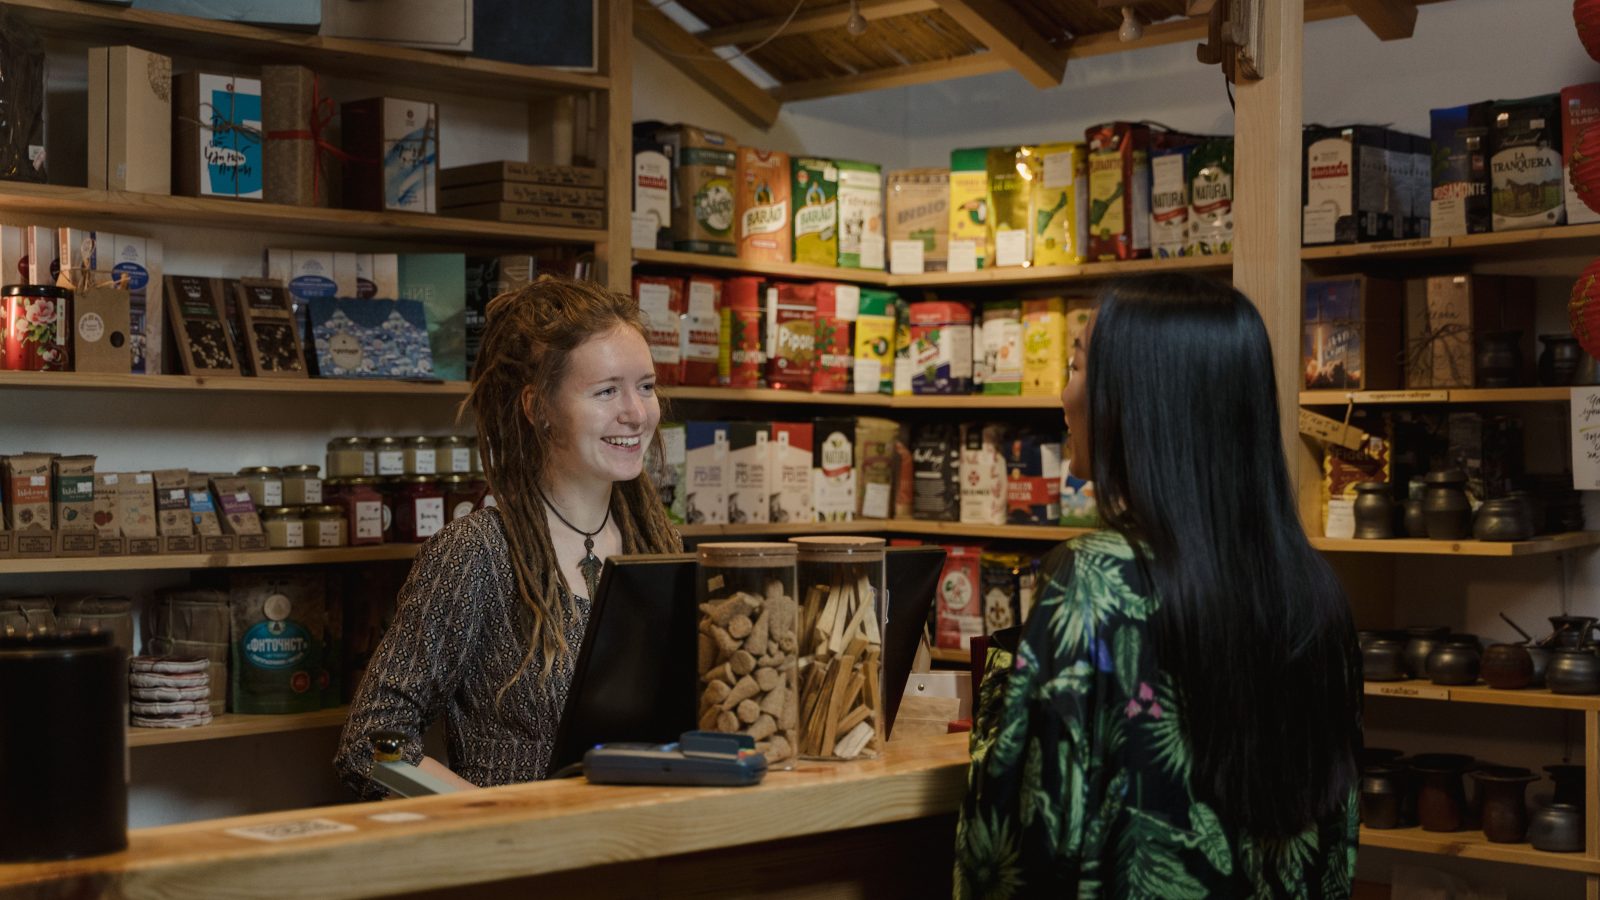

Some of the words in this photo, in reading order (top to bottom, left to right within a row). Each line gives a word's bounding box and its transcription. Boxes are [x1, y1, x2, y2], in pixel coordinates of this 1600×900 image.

[1514, 151, 1526, 160] LA
[1492, 156, 1552, 174] TRANQUERA
[1153, 190, 1185, 209] NATURA
[1194, 183, 1227, 201] NATURA
[897, 199, 947, 225] INDIO
